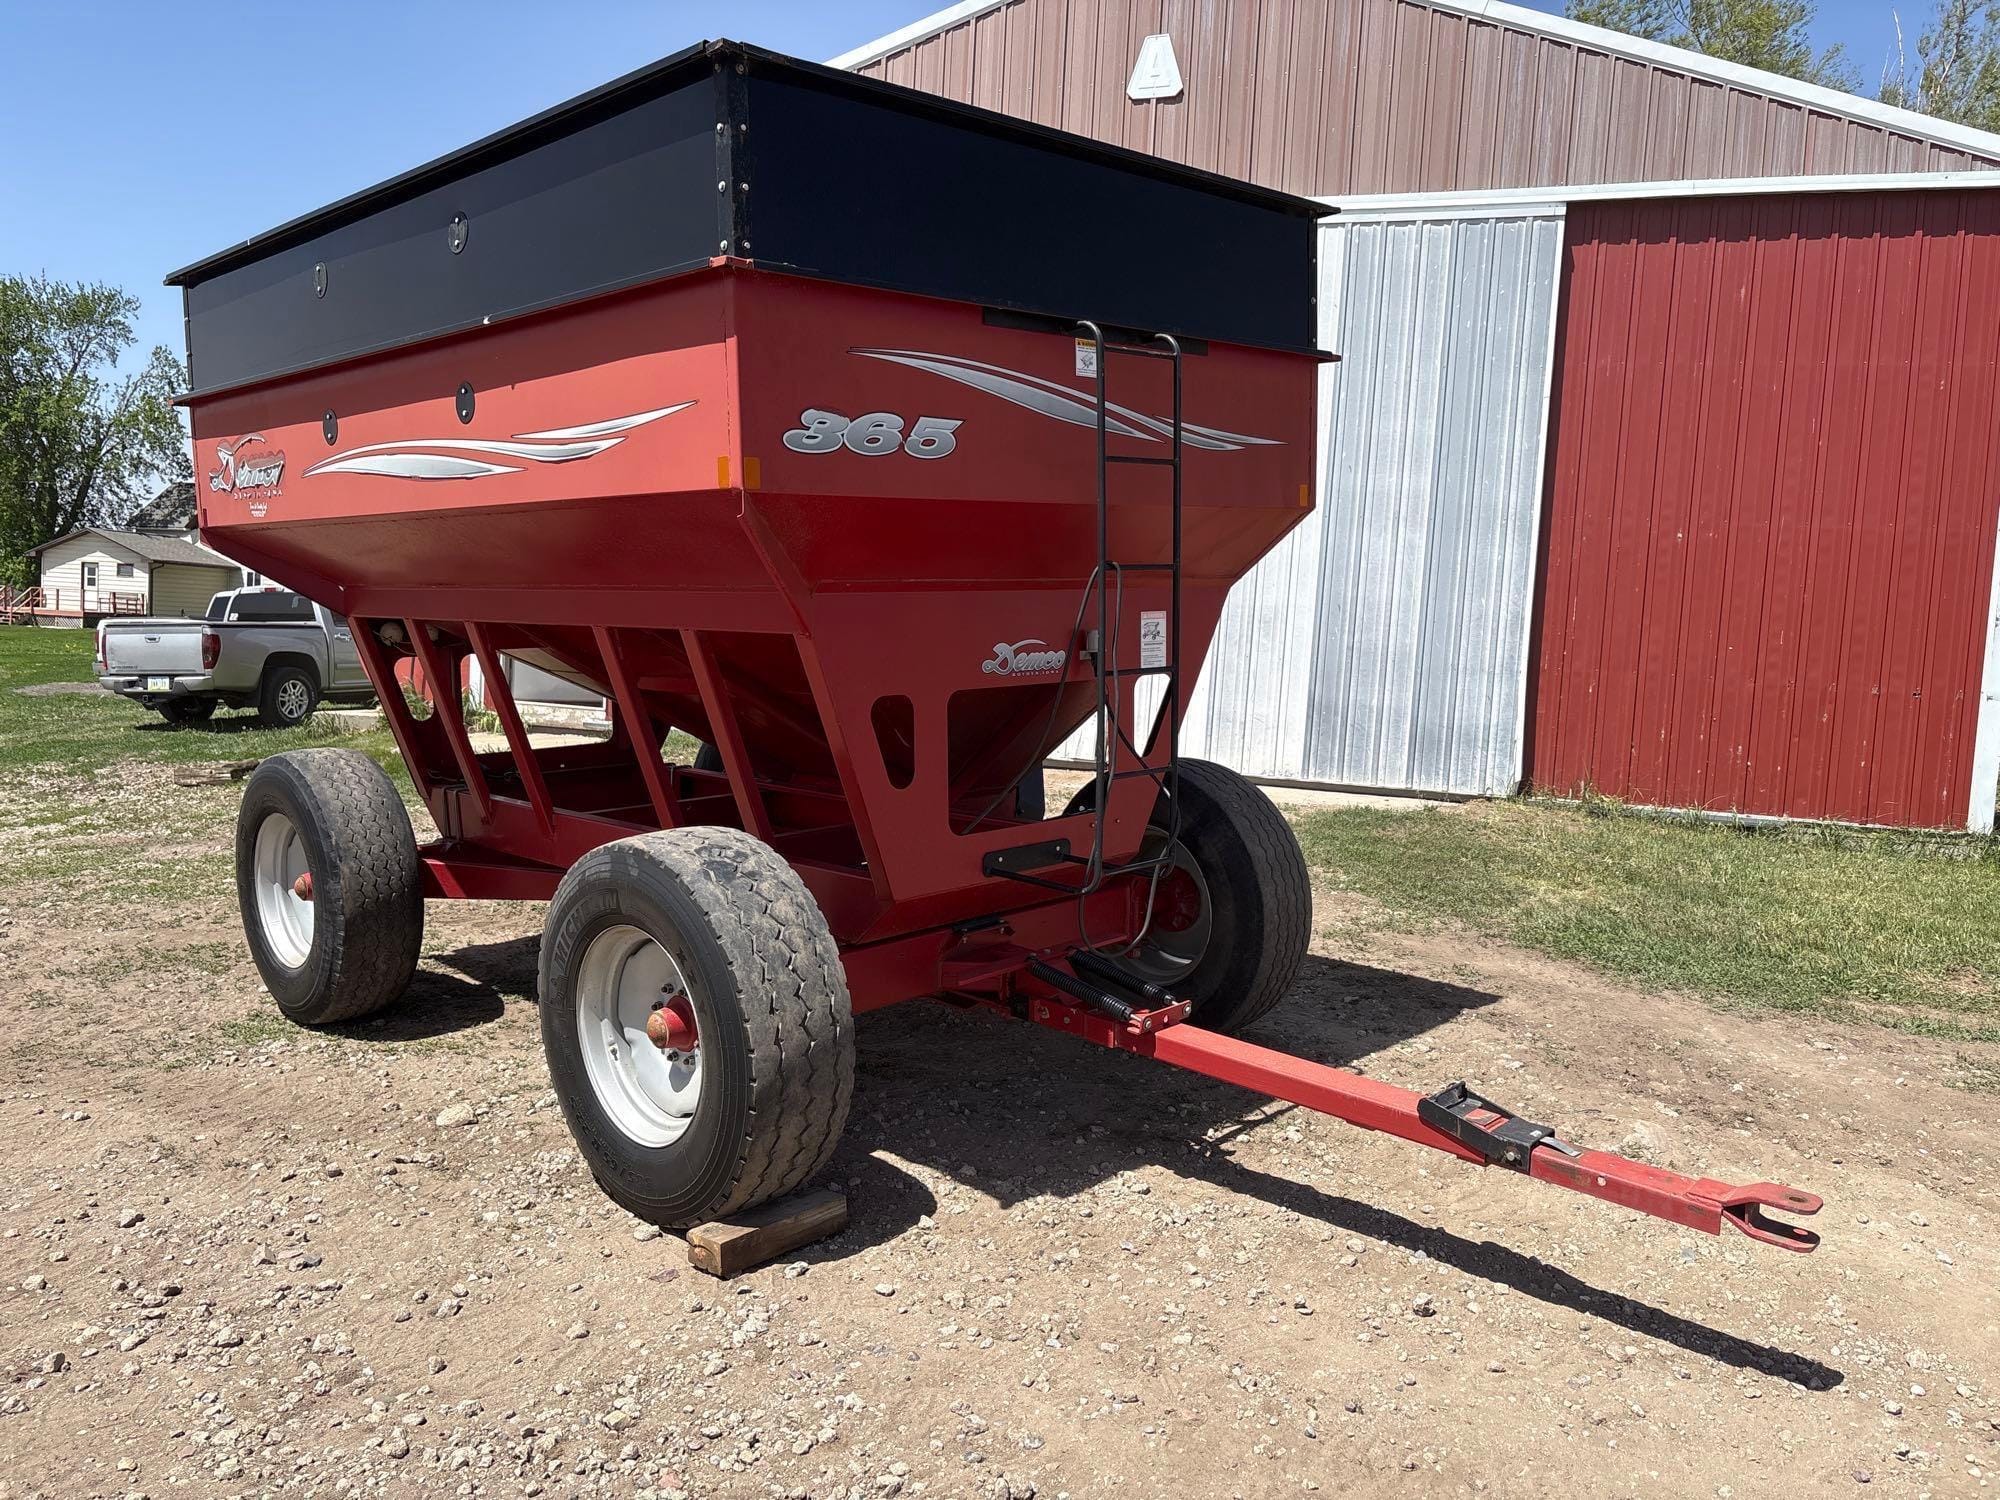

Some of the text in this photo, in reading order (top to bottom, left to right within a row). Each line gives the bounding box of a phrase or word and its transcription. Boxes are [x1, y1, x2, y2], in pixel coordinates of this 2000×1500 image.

[782, 408, 965, 459] 365
[982, 639, 1066, 675] Demco
[553, 890, 620, 973] MICHEIN
